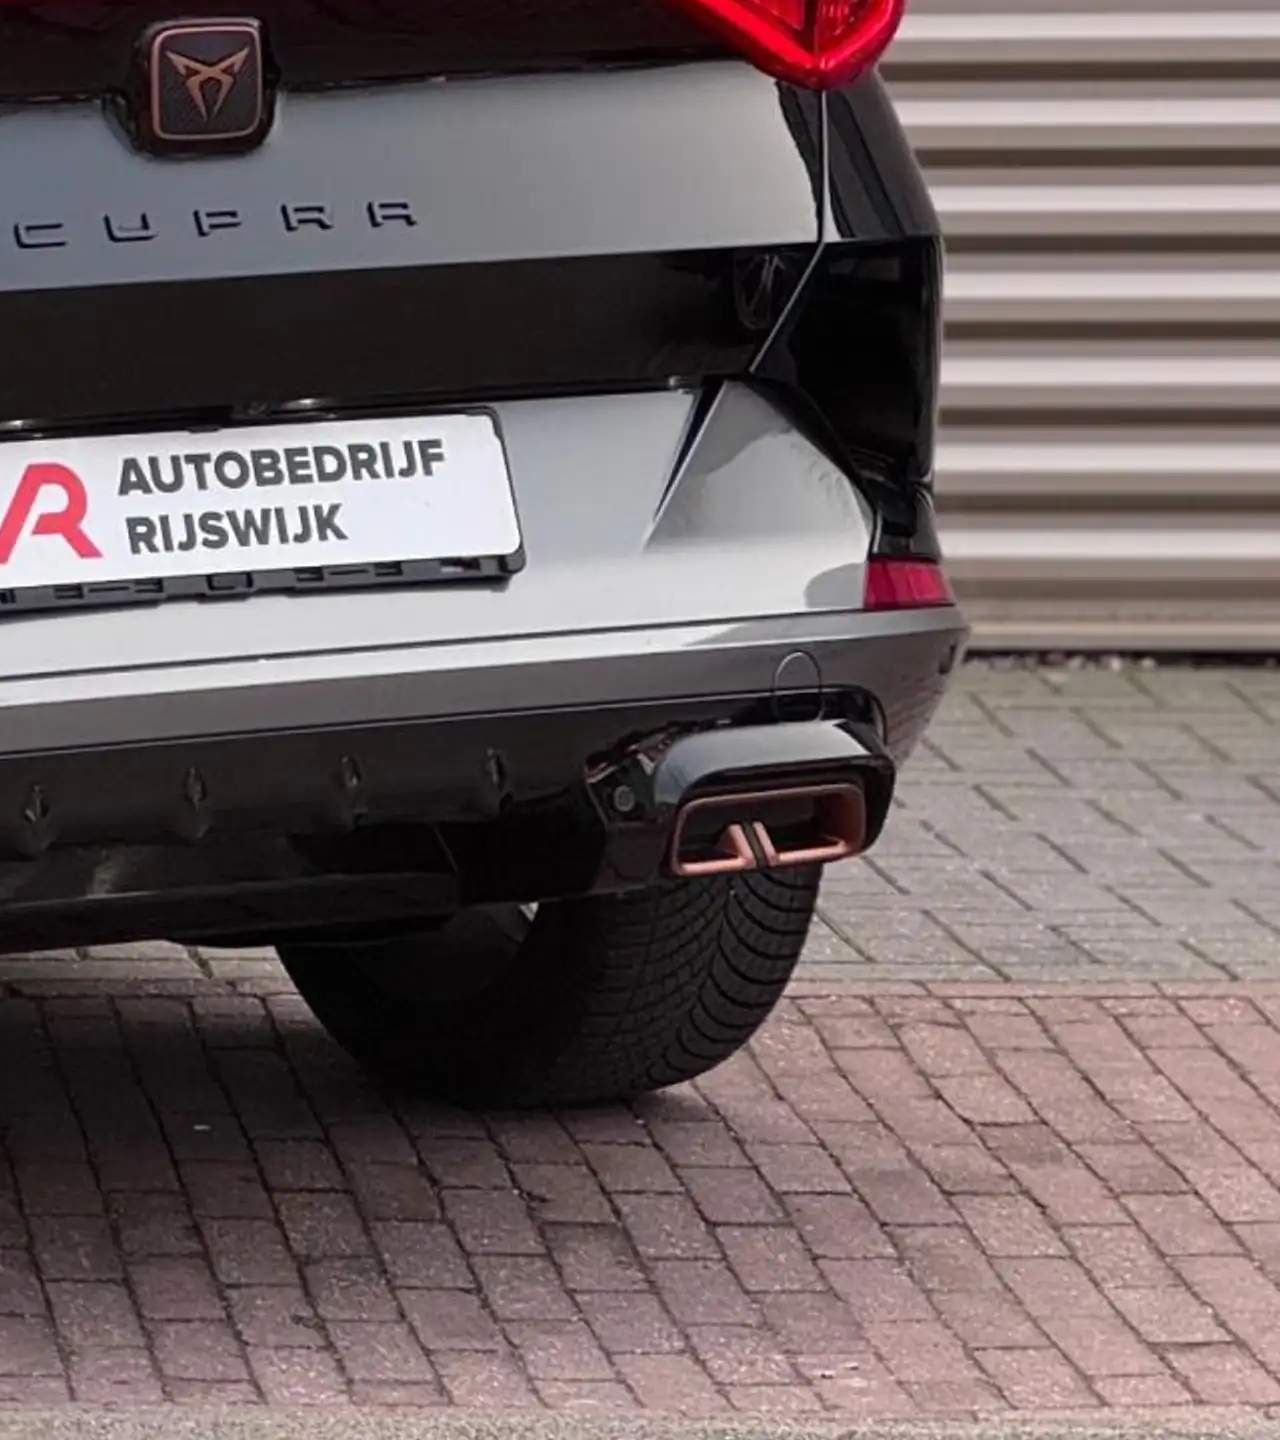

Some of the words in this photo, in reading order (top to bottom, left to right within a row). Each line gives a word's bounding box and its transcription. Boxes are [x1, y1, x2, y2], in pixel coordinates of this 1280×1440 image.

[13, 200, 418, 249] CUPRA
[118, 439, 445, 496] AUTOBEDRIJF
[126, 504, 347, 555] RIJSWIJK
